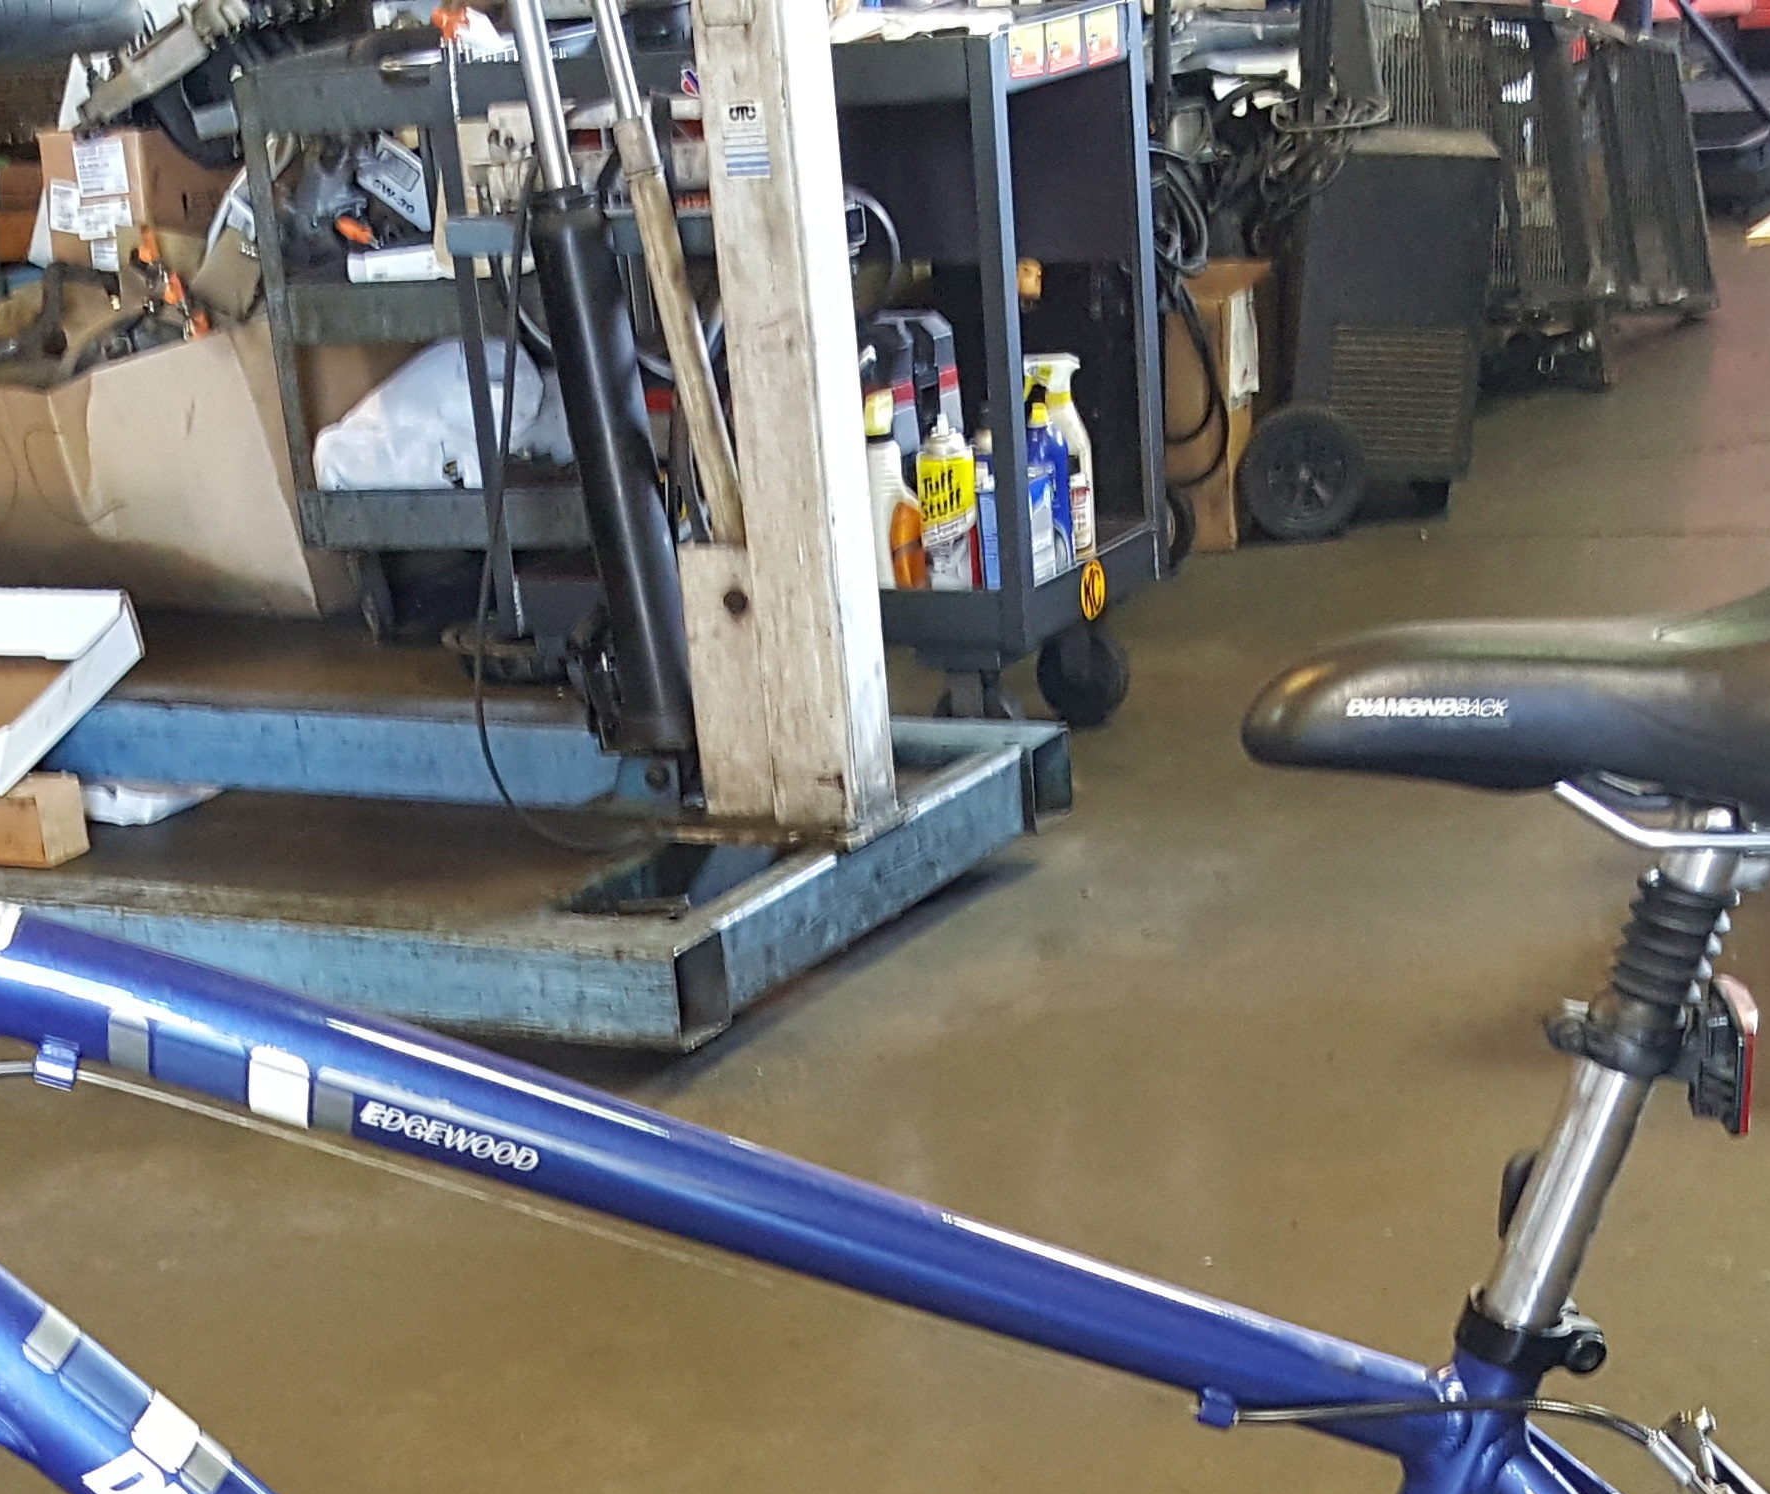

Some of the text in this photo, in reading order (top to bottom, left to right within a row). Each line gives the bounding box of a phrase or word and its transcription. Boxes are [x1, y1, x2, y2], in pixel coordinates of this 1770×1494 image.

[923, 469, 953, 499] Tuff
[920, 487, 960, 522] Stuff
[1084, 567, 1102, 618] KC
[1346, 697, 1509, 718] DIAMONDBACK
[360, 1100, 539, 1172] EDGEWOOD
